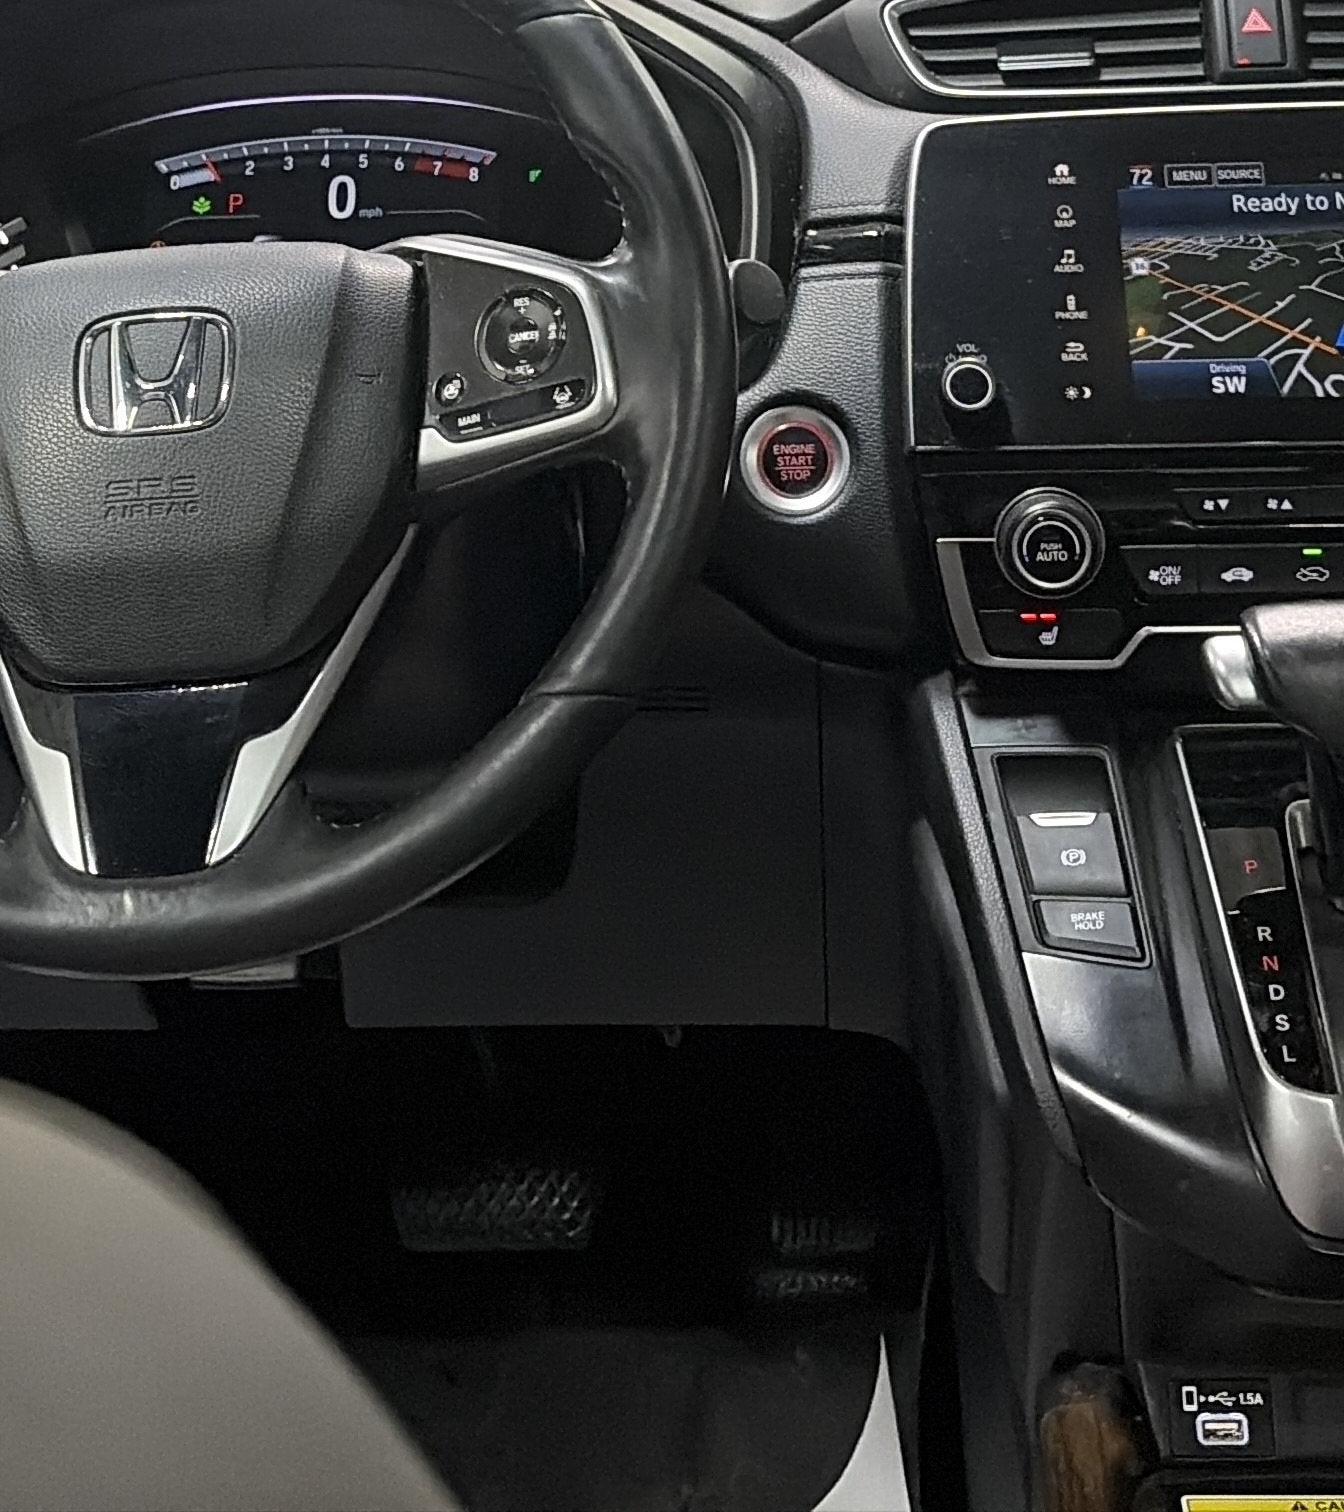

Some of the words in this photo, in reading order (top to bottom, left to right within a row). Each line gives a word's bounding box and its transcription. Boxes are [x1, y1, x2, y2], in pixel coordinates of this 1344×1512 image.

[169, 175, 180, 191] 0
[244, 160, 255, 176] 2
[283, 155, 294, 171] 3
[319, 154, 330, 169] 4
[358, 153, 369, 169] 5
[394, 156, 405, 172] 6
[432, 161, 443, 176] 7
[468, 166, 479, 182] 8
[1128, 168, 1154, 186] 72
[1171, 170, 1207, 182] MENU
[1217, 168, 1261, 180] SOURCE
[1048, 176, 1077, 185] HOME
[328, 174, 356, 220] 0
[358, 207, 384, 219] mph
[228, 193, 244, 214] P
[1231, 193, 1299, 216] Ready
[1306, 194, 1329, 210] to
[1054, 219, 1077, 228] MAP
[1053, 264, 1084, 274] AUDIO
[1055, 310, 1088, 320] PHONE
[956, 343, 979, 354] VOL
[1060, 352, 1088, 362] BACK
[1209, 364, 1247, 375] Driving
[1211, 376, 1247, 394] SW
[457, 413, 481, 428] MAIN
[772, 444, 816, 455] ENGINE
[776, 455, 814, 467] START
[780, 469, 811, 481] STOP
[1040, 542, 1062, 551] PUSH
[1036, 551, 1068, 563] AUTO
[1159, 565, 1181, 576] ON/
[1159, 574, 1182, 585] OFF
[1243, 860, 1258, 875] P
[1070, 911, 1106, 924] BRAKE
[1074, 920, 1105, 931] HOLD
[1257, 926, 1274, 942] R
[1262, 956, 1280, 972] N
[1268, 984, 1286, 1001] D
[1275, 1014, 1290, 1031] S
[1282, 1046, 1297, 1063] L
